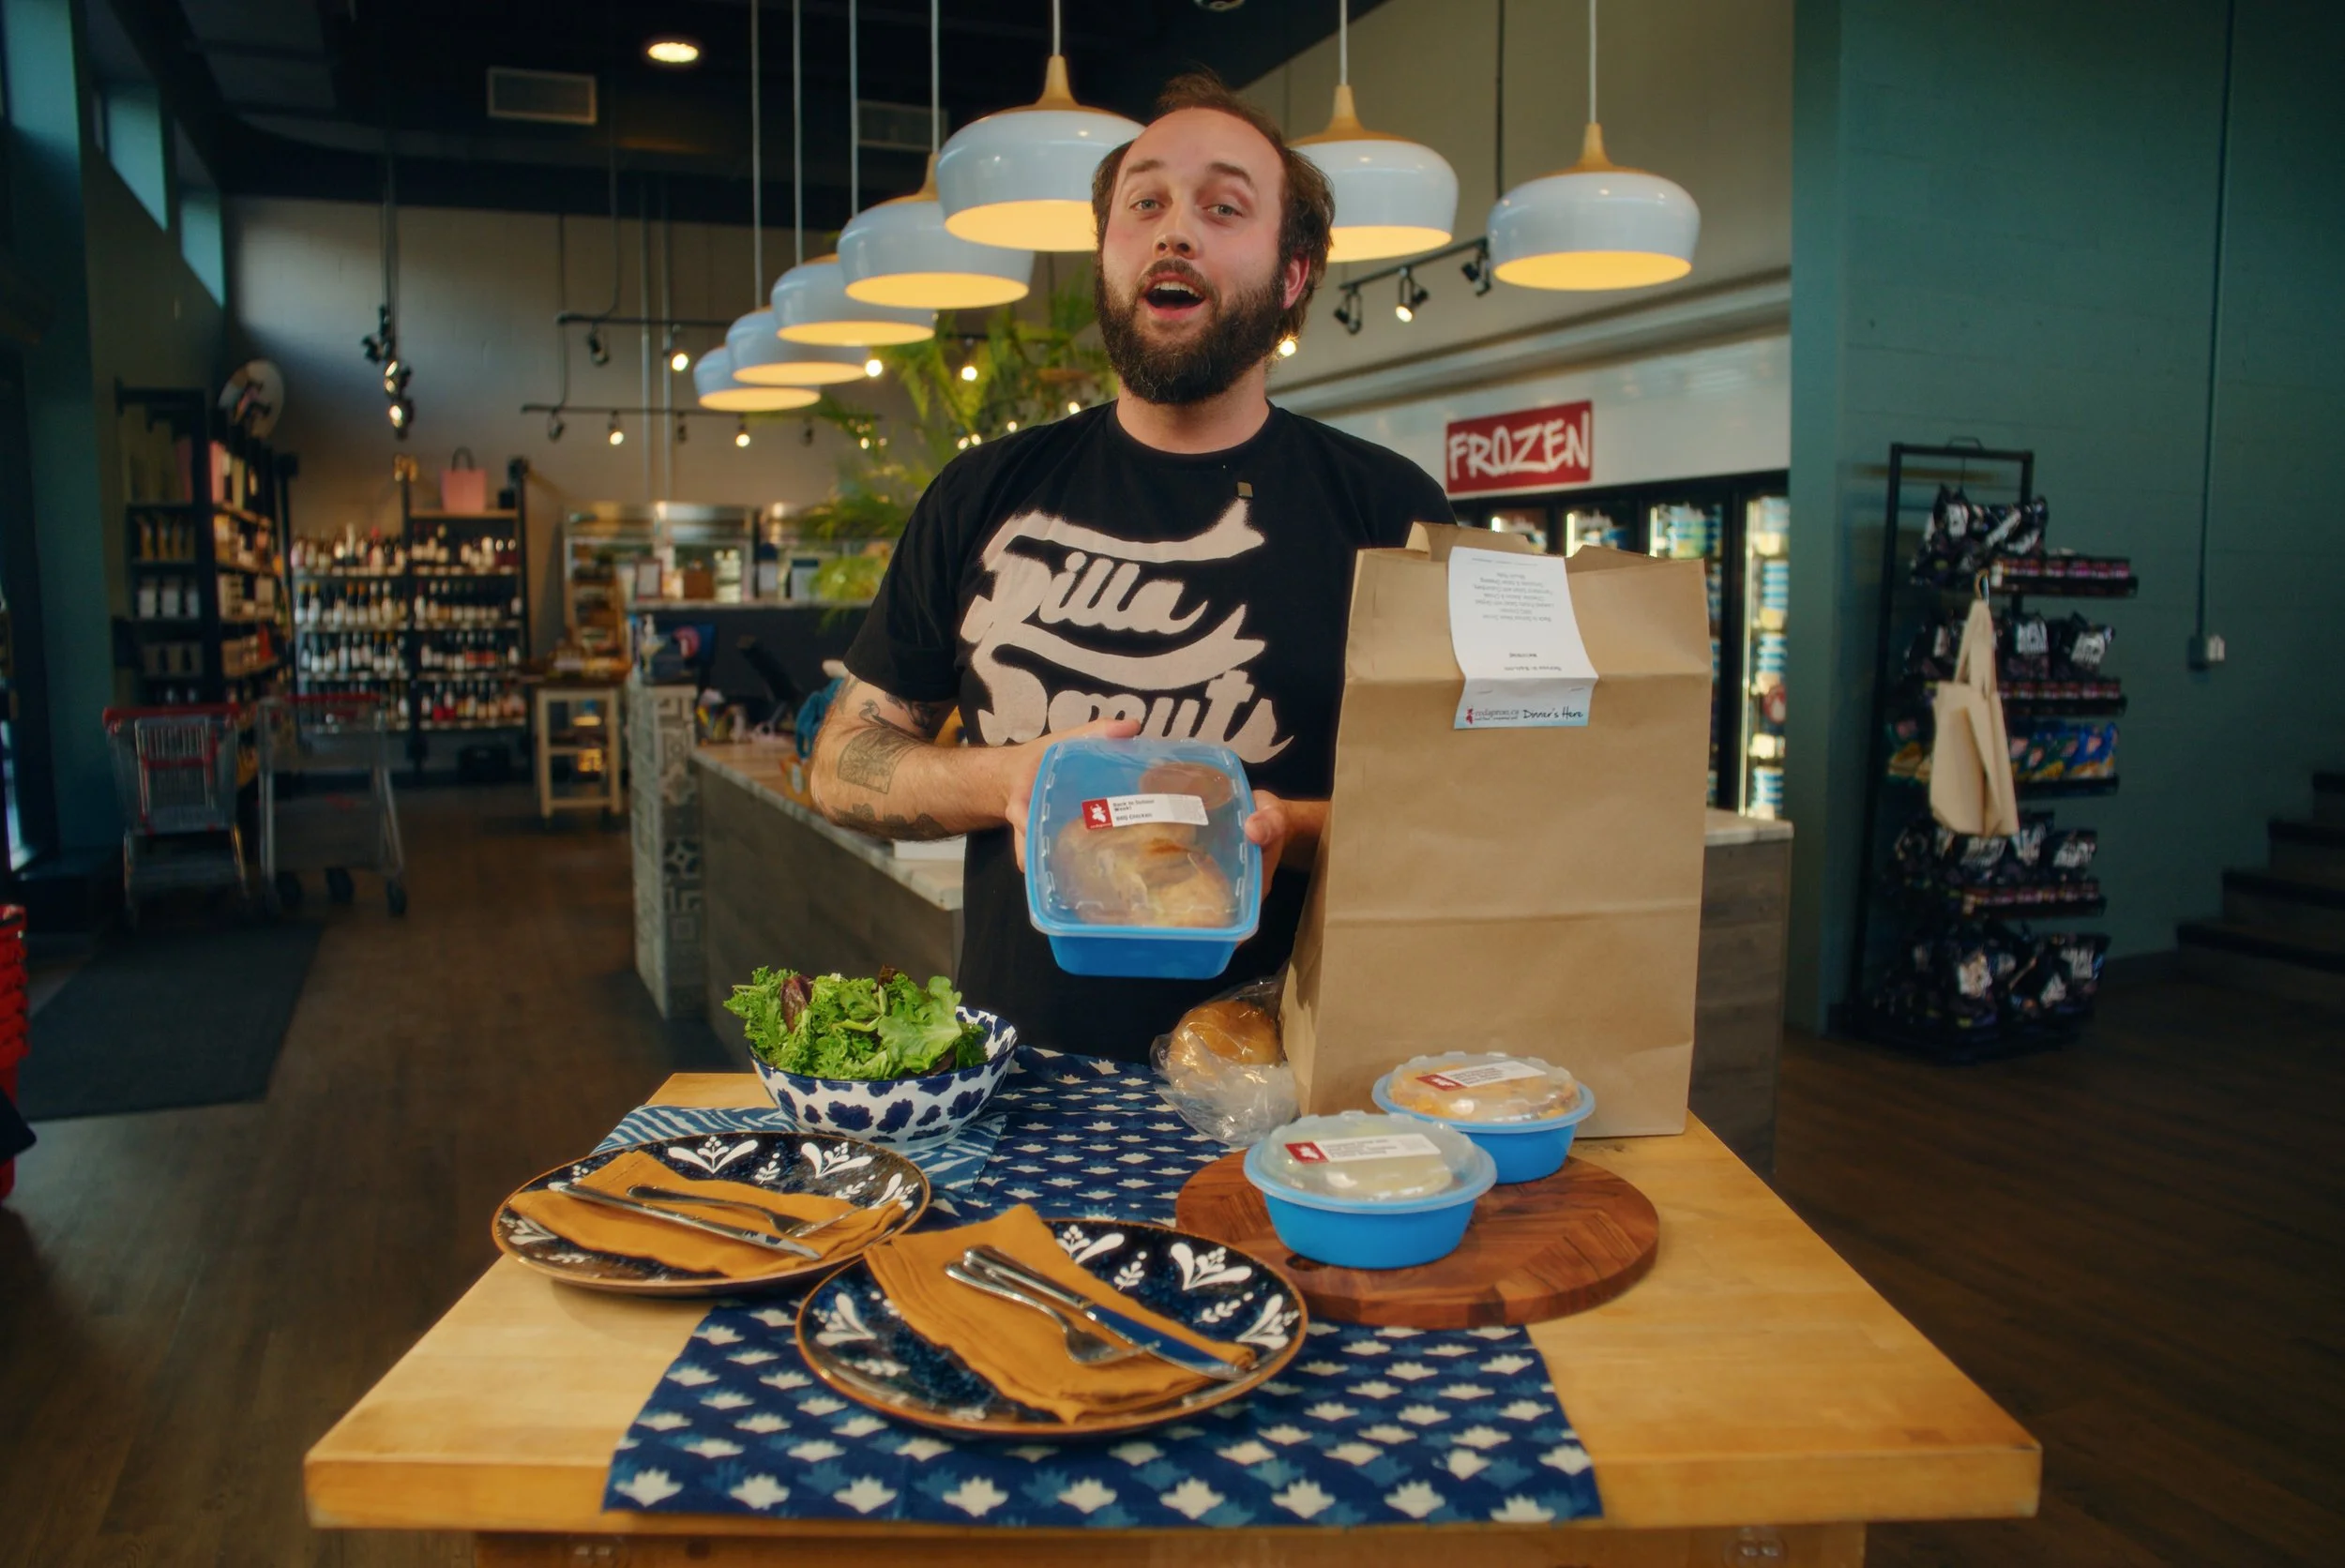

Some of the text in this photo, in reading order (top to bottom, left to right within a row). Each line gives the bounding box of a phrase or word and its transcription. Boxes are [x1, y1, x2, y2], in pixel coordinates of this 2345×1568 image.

[1449, 411, 1590, 480] FROZEN
[1523, 707, 1559, 719] Dinner's
[1562, 706, 1583, 720] Here
